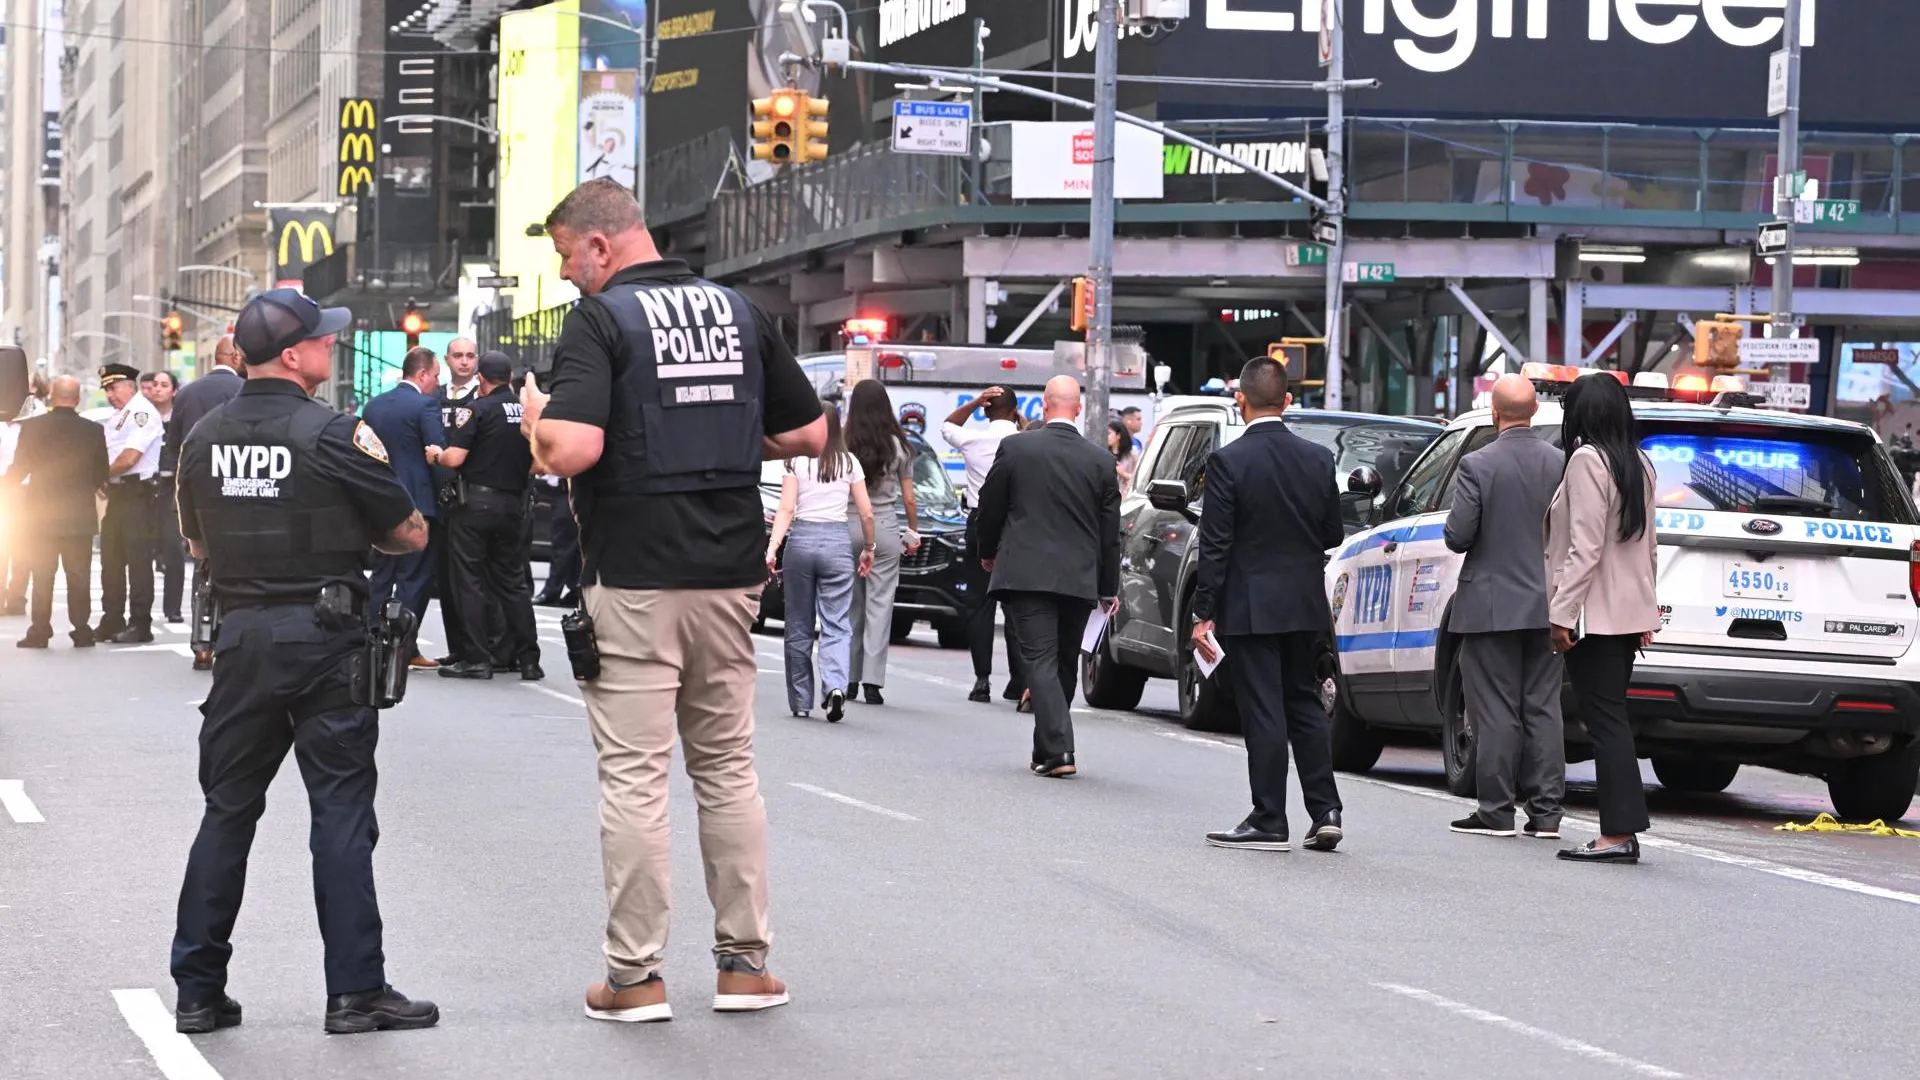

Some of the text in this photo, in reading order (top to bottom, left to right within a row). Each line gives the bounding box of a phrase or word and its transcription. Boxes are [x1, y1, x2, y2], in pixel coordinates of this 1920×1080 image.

[915, 105, 965, 116] BUS LANE
[919, 118, 963, 128] BUSES ONLY
[940, 140, 962, 148] TURNS
[1074, 139, 1095, 149] MIN
[1814, 203, 1825, 220] W
[1828, 203, 1845, 221] 42
[1359, 265, 1369, 280] W
[1370, 265, 1384, 280] 42
[634, 286, 733, 328] NYPD
[651, 326, 743, 363] POLICE
[1855, 351, 1896, 362] MINISO
[211, 444, 291, 479] NYPD
[1651, 444, 1799, 469] DO YOUR
[223, 477, 277, 488] EMERGENCY
[221, 486, 280, 497] SERVICE UNIT
[1655, 511, 1705, 530] YPD
[1804, 520, 1893, 544] POLICE
[1729, 570, 1789, 591] 4550 18
[1353, 563, 1392, 625] NYPD
[1730, 607, 1802, 622] @NYPDMTS
[1849, 623, 1887, 633] PAL CARES
